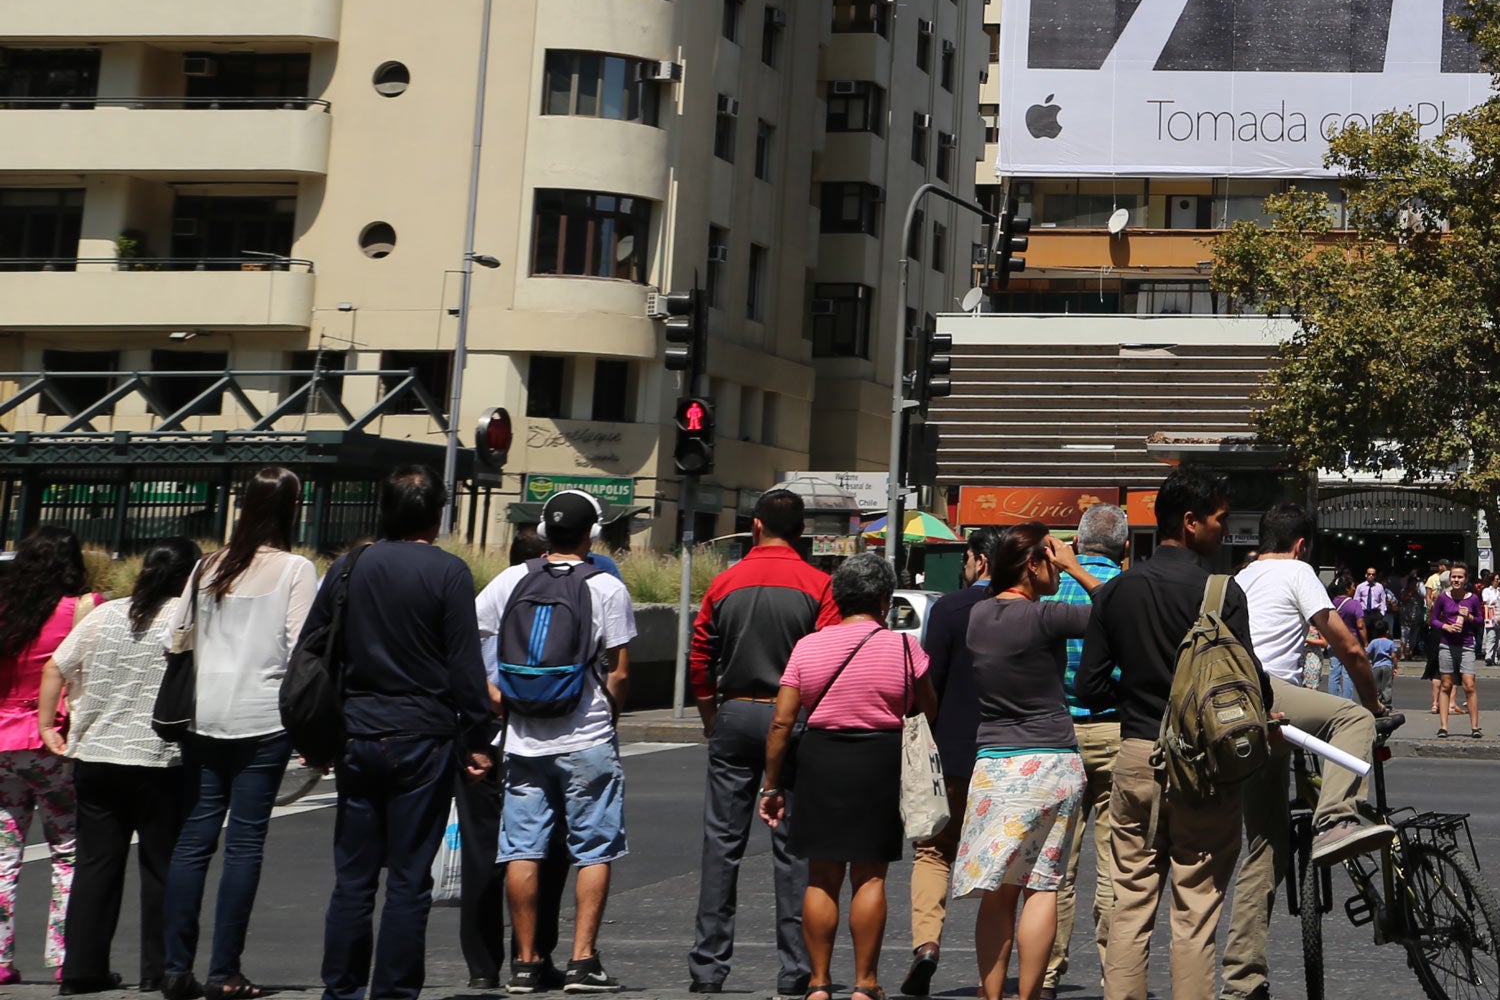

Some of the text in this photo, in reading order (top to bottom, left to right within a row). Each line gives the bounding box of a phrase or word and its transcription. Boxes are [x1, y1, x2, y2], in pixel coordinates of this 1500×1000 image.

[1147, 100, 1308, 142] Tomada
[554, 482, 629, 495] INDIANAPOLIS
[858, 499, 878, 507] Chile
[1000, 490, 1074, 519] Lirio
